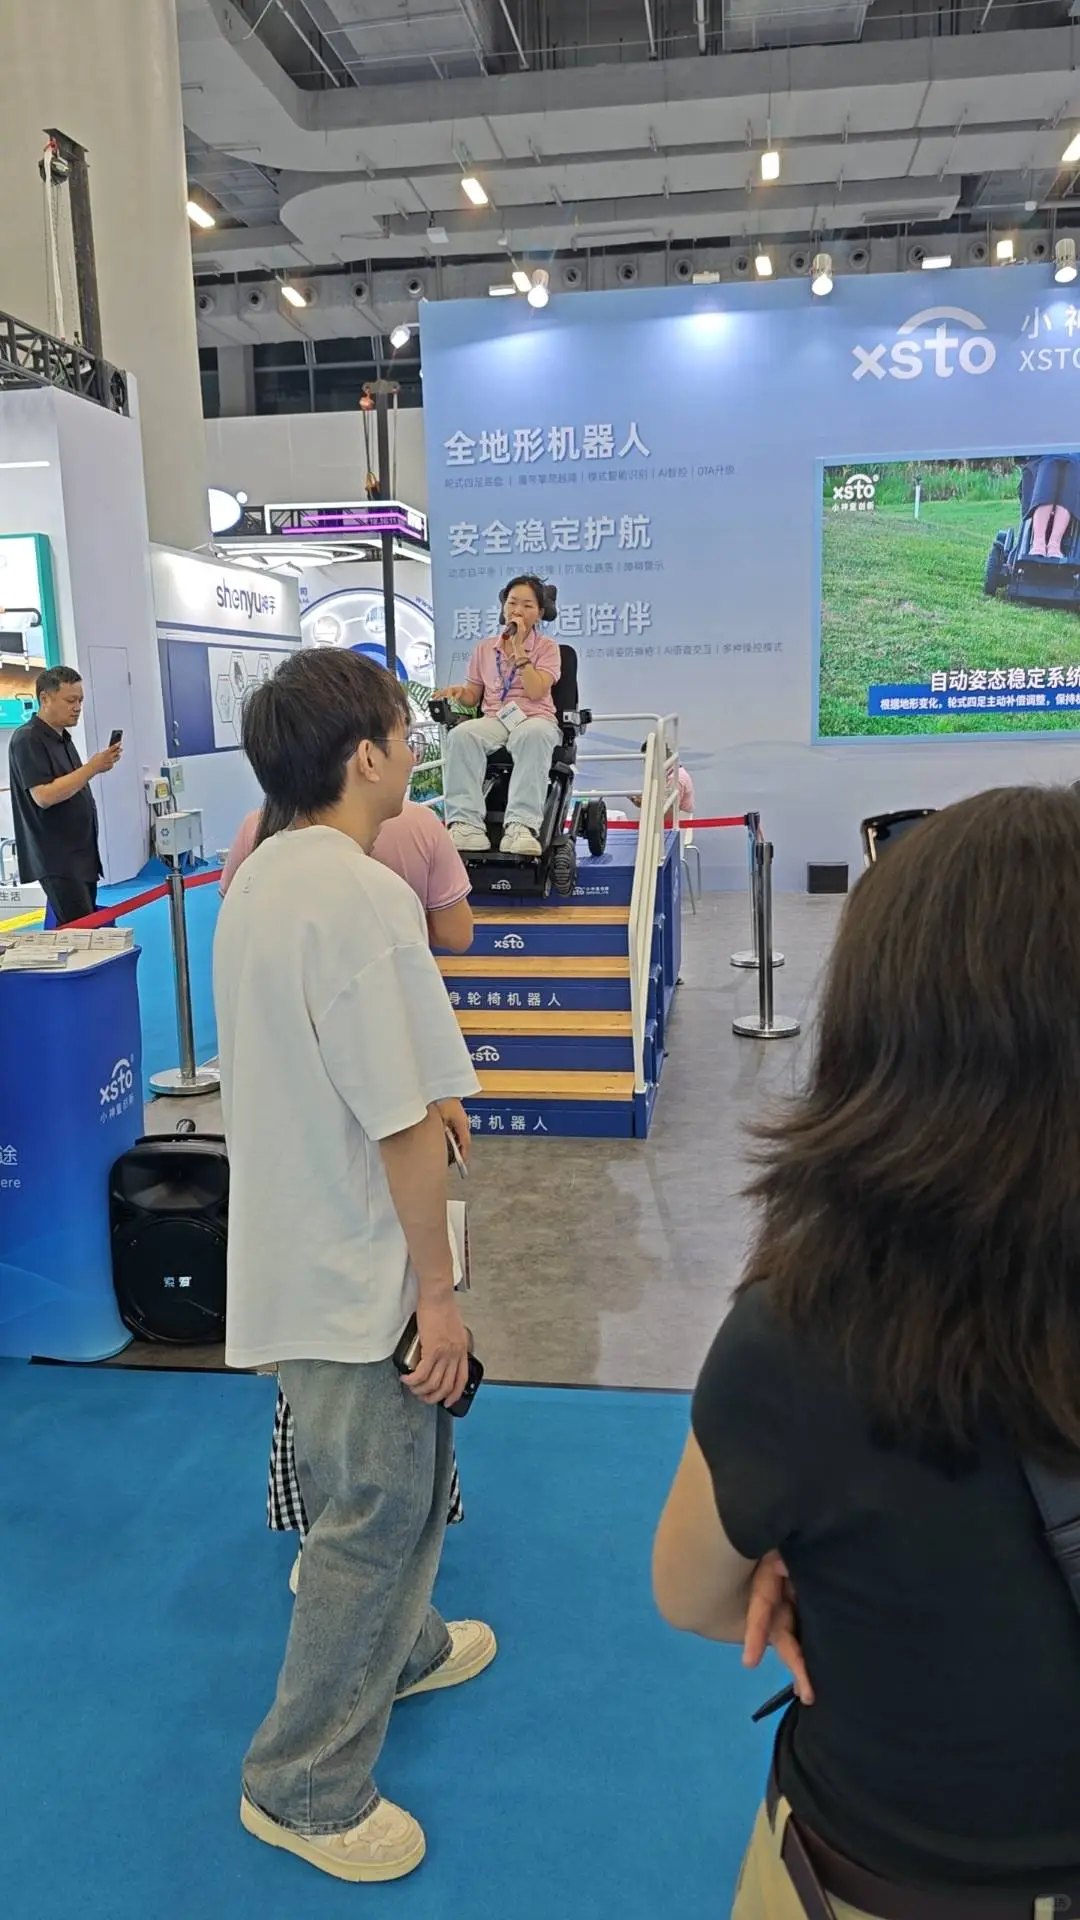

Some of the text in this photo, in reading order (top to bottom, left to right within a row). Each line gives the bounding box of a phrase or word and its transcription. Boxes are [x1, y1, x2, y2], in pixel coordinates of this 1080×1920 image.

[852, 321, 996, 381] xsto
[444, 422, 650, 467] 全地形机器人
[833, 480, 875, 500] xsto
[448, 514, 652, 556] 安全稳定护航
[452, 600, 652, 641] 康适陪伴
[931, 665, 1080, 693] 自动姿态稳定系统
[494, 937, 525, 950] xsto
[100, 1068, 133, 1106] xsto
